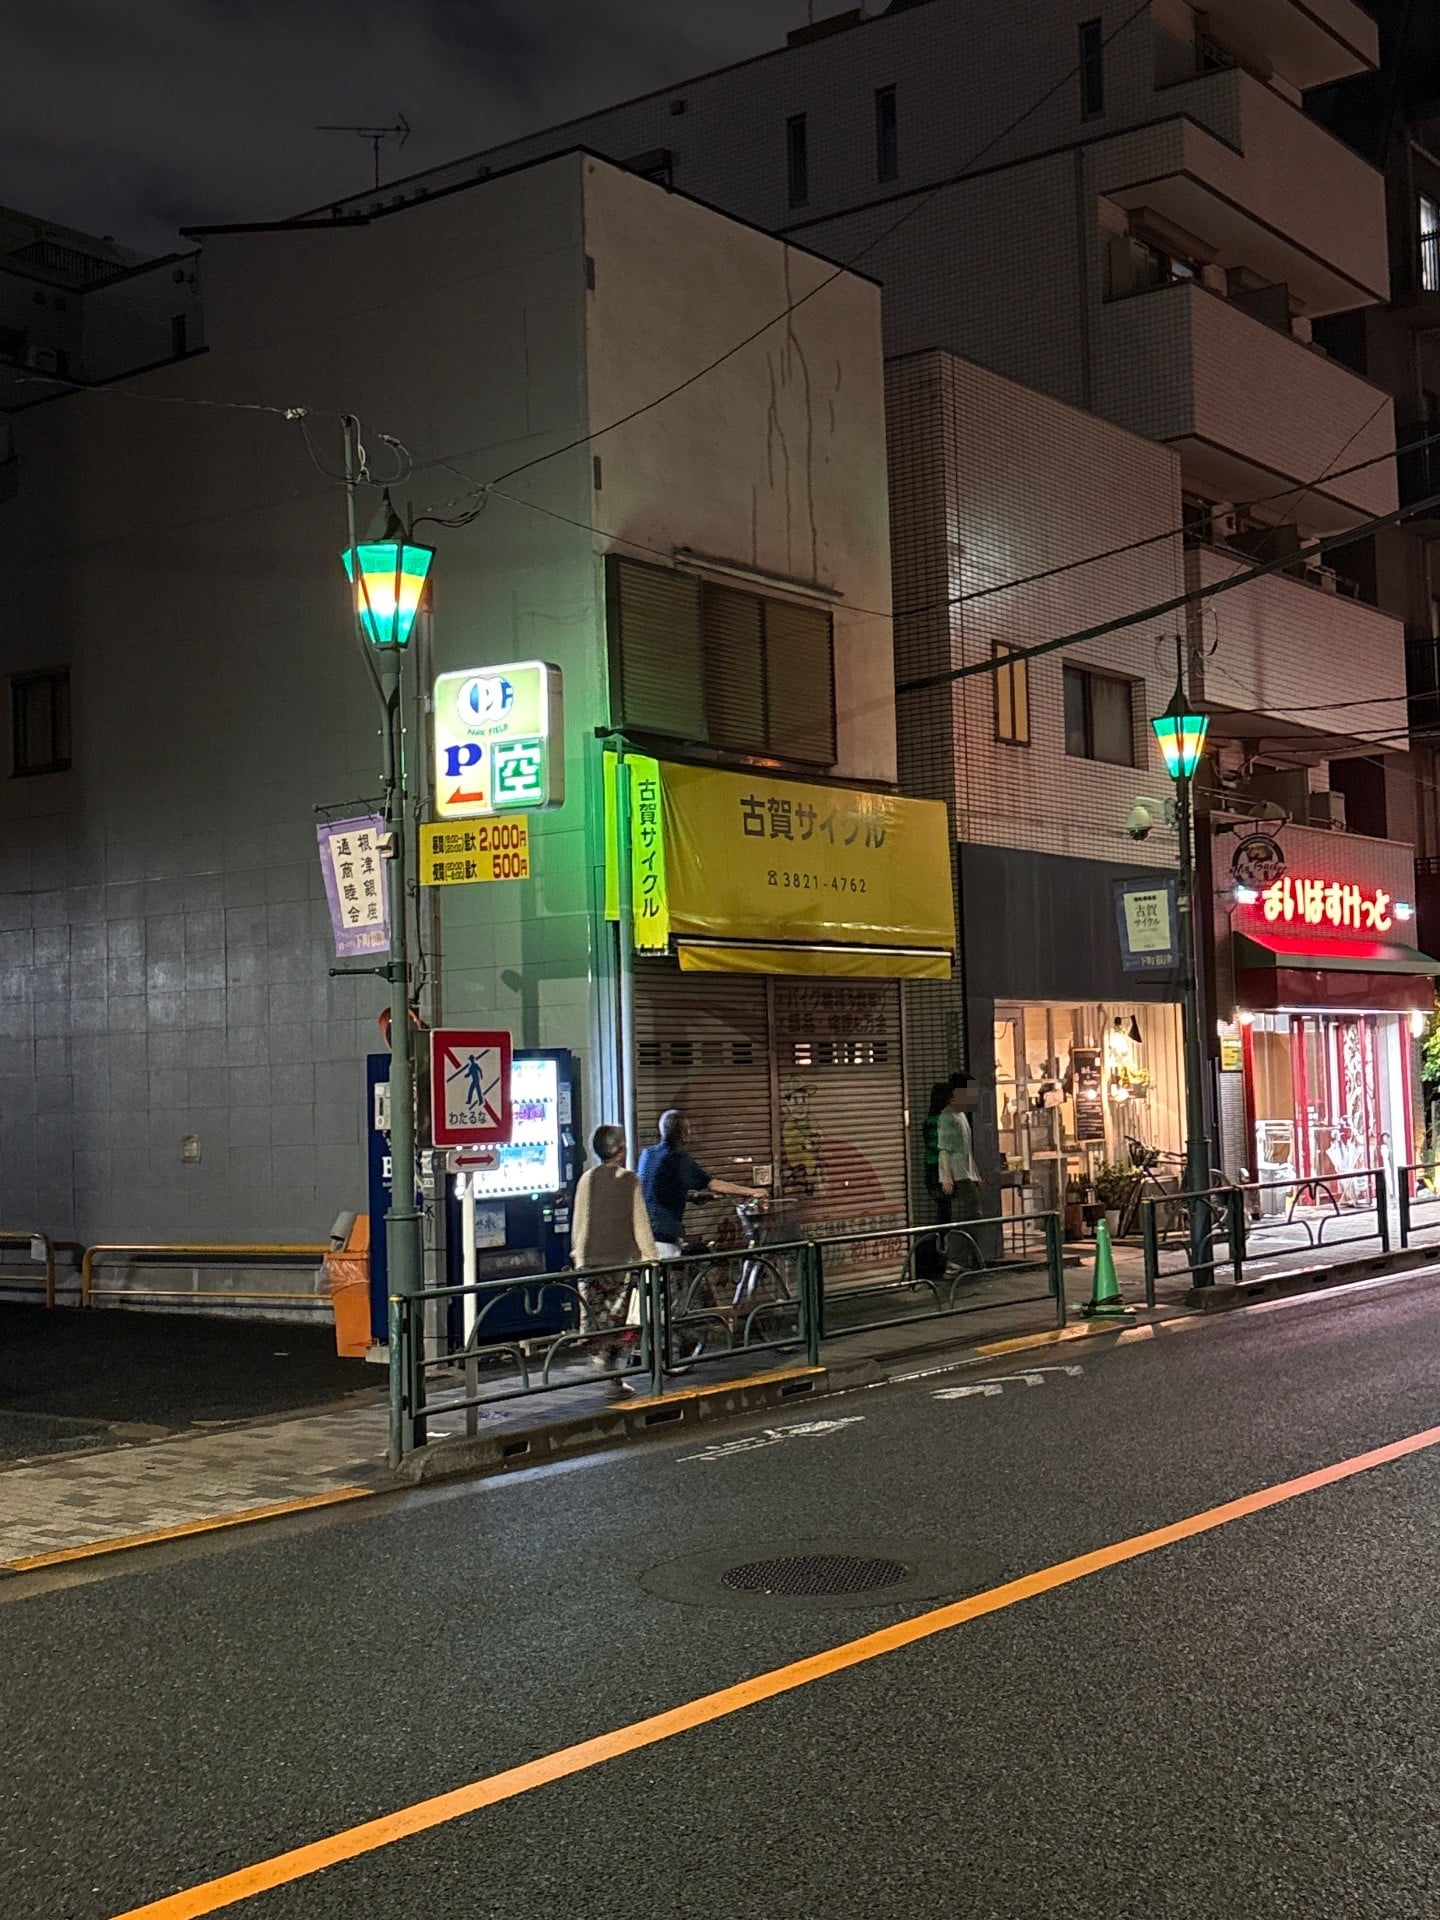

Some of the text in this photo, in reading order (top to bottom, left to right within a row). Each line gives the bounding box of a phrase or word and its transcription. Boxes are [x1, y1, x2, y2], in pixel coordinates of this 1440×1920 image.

[444, 743, 482, 777] P
[495, 742, 541, 804] 空
[479, 824, 527, 852] 2,000円
[739, 794, 887, 849] 古賀サイクル
[638, 778, 660, 918] 古賀サイクル
[492, 852, 528, 879] 500円
[783, 874, 867, 894] 3821-4762
[1262, 876, 1392, 931] まいばすけっと
[448, 1111, 488, 1126] わたるな
